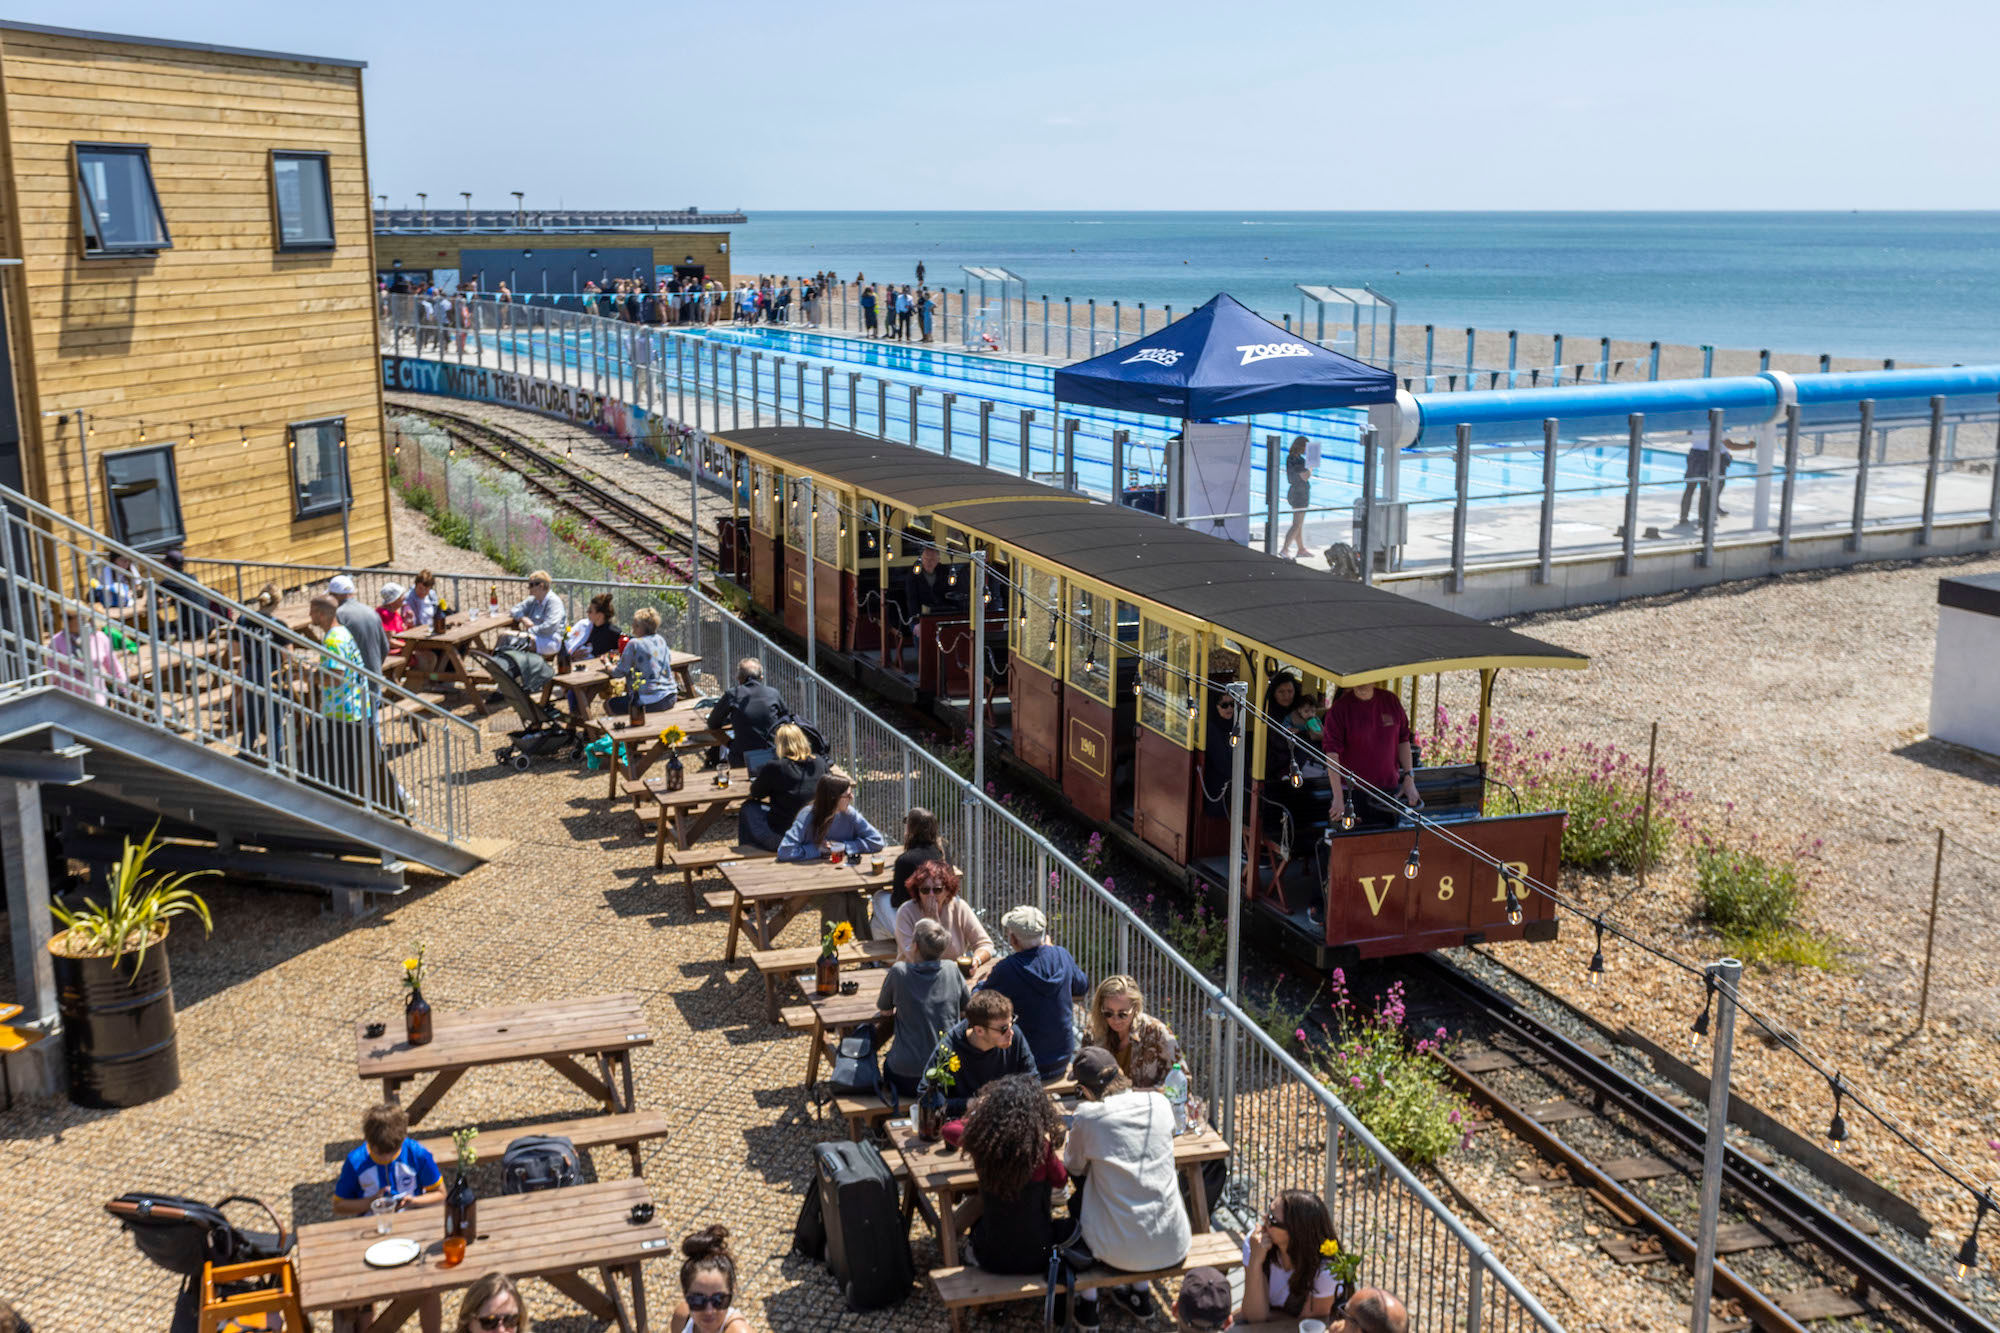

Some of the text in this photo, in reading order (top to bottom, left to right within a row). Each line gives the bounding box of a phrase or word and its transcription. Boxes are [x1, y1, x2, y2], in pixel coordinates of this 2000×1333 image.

[1120, 348, 1184, 367] ZOGGS
[1236, 343, 1314, 366] ZOGGS
[400, 360, 441, 391] CITY
[447, 365, 489, 397] WITH
[491, 372, 518, 401] THE
[519, 378, 575, 419] NATURAL
[1081, 737, 1096, 759] 1901
[1358, 861, 1531, 917] V 8 R
